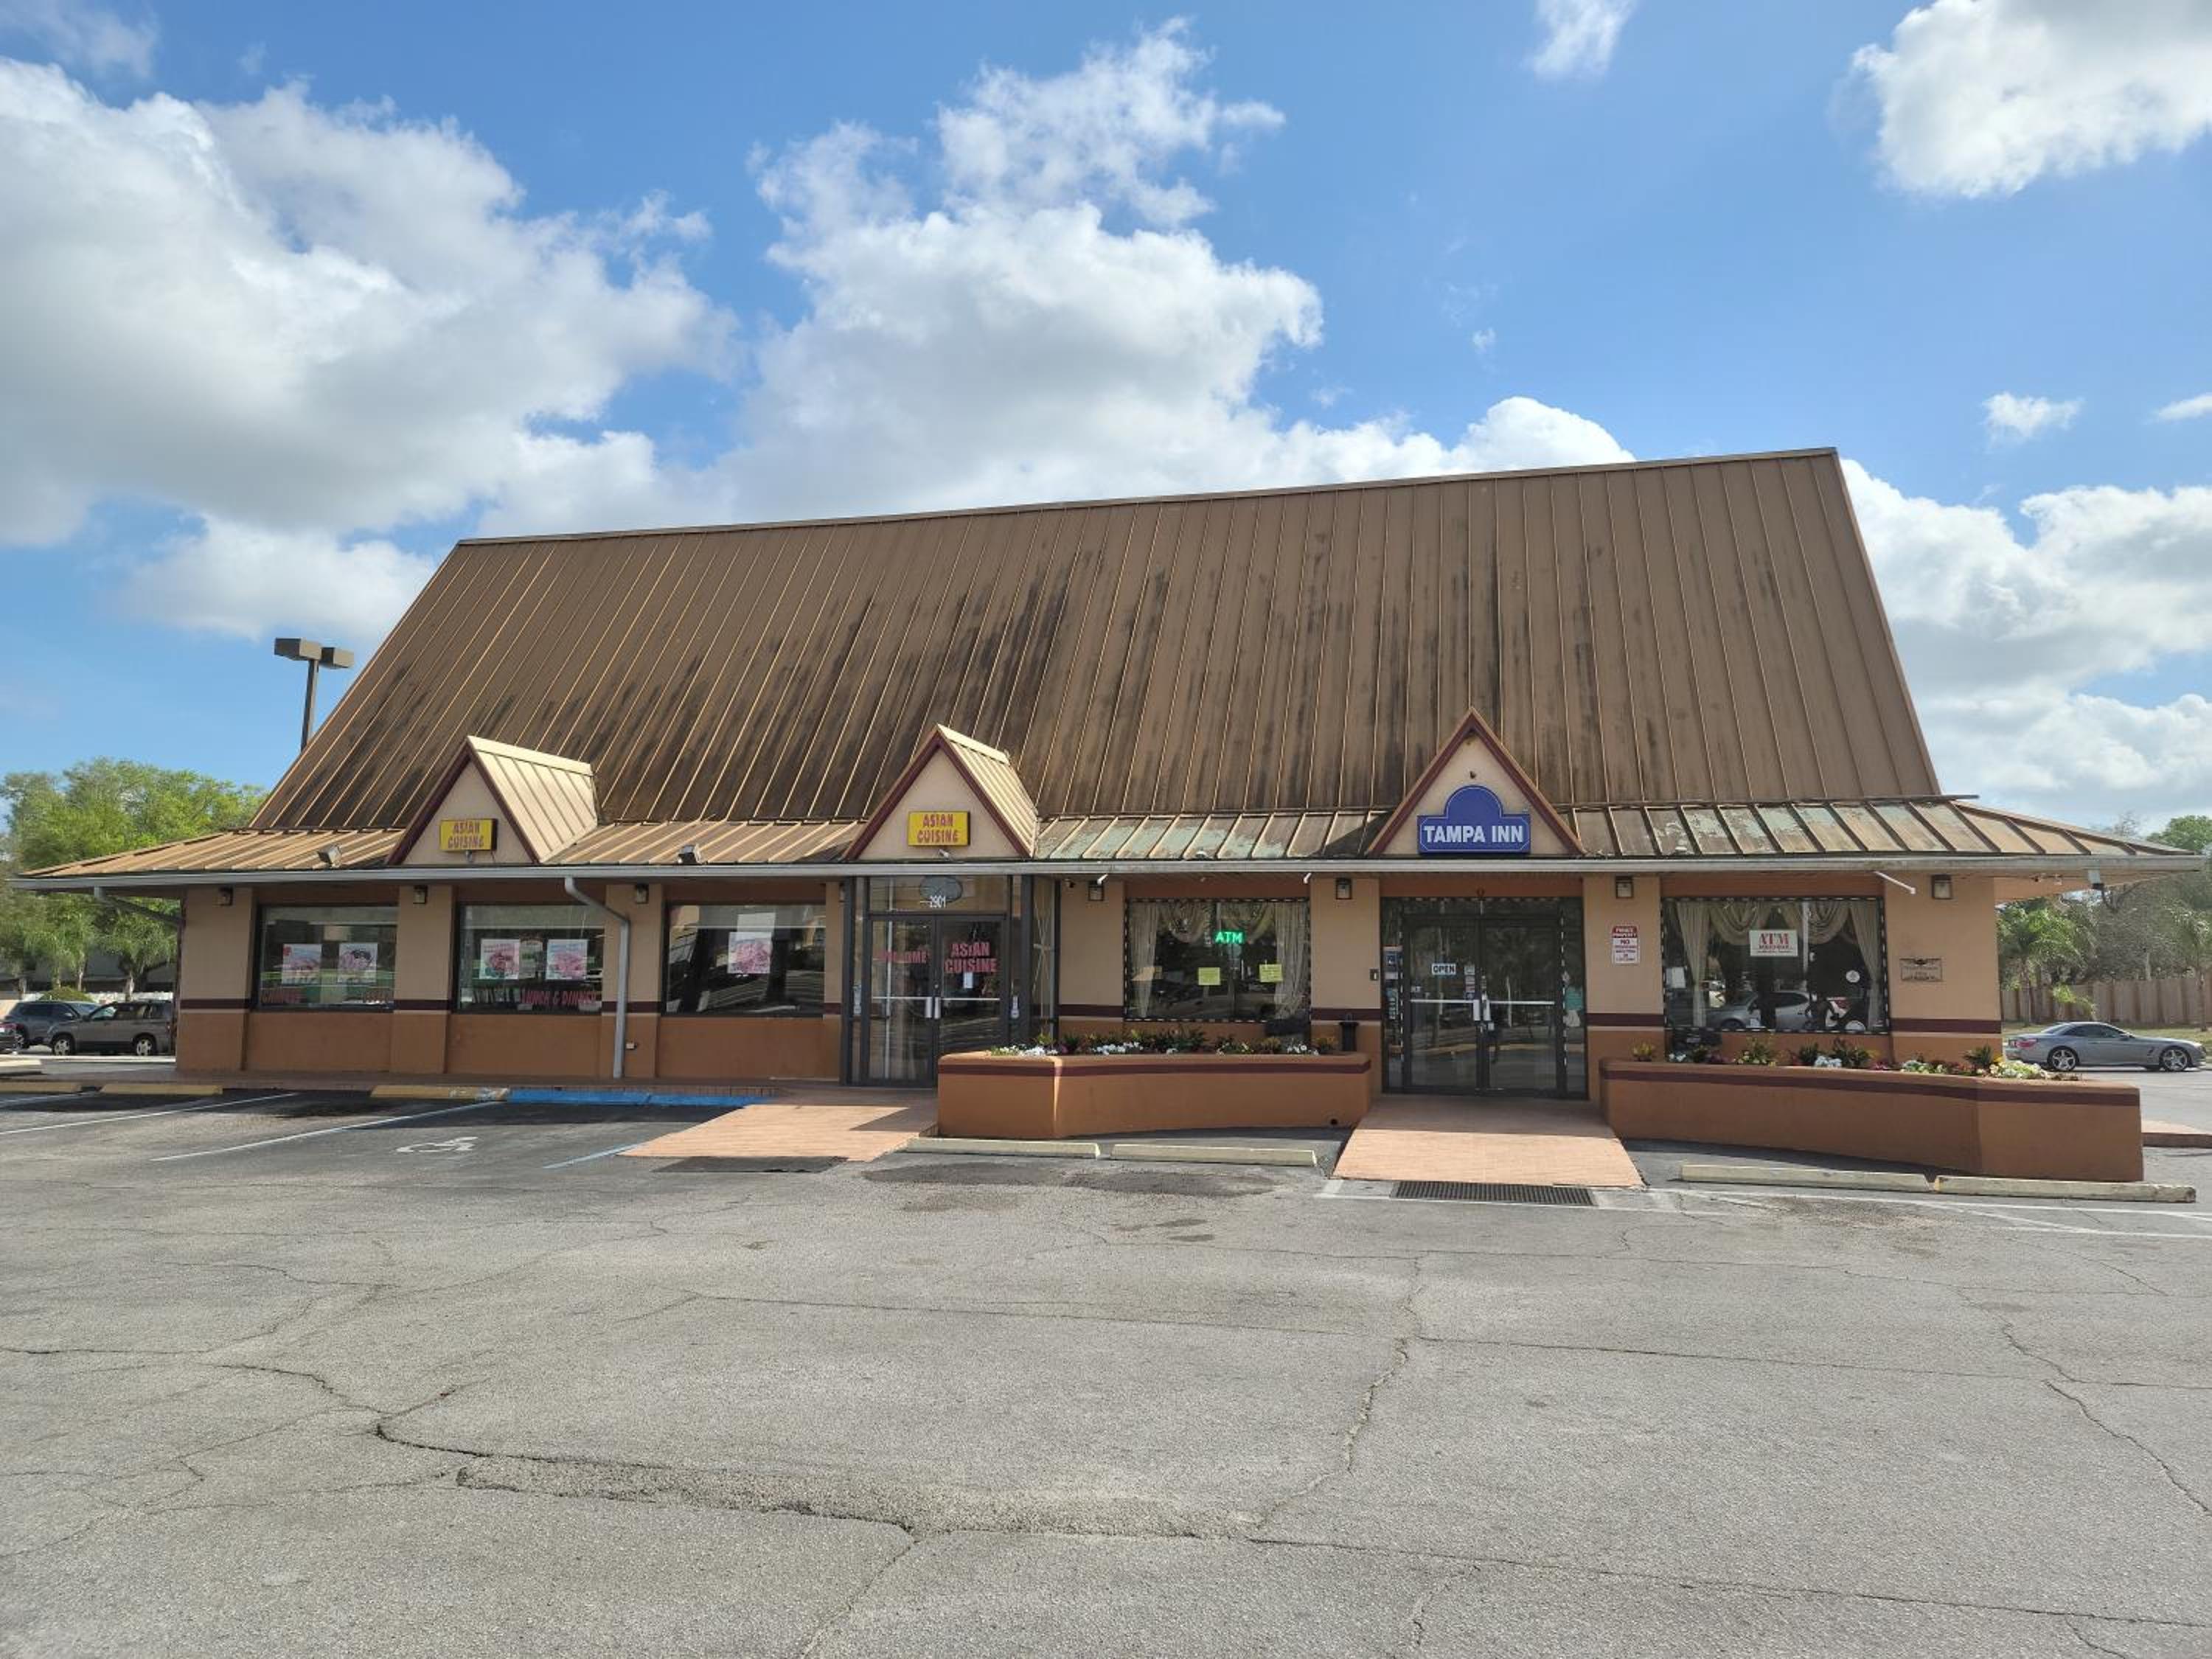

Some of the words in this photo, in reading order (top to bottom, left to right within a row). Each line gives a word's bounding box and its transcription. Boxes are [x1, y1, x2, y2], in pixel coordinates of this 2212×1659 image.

[922, 813, 953, 827] ASIAN
[453, 821, 480, 834] ASIAN
[1424, 825, 1486, 843] TAMPA
[1492, 825, 1523, 843] INN
[917, 830, 959, 843] CUISINE
[1215, 931, 1243, 943] ATM
[950, 942, 990, 958] ASIAN
[945, 959, 998, 973] CUISINE
[1433, 965, 1455, 973] OPEN
